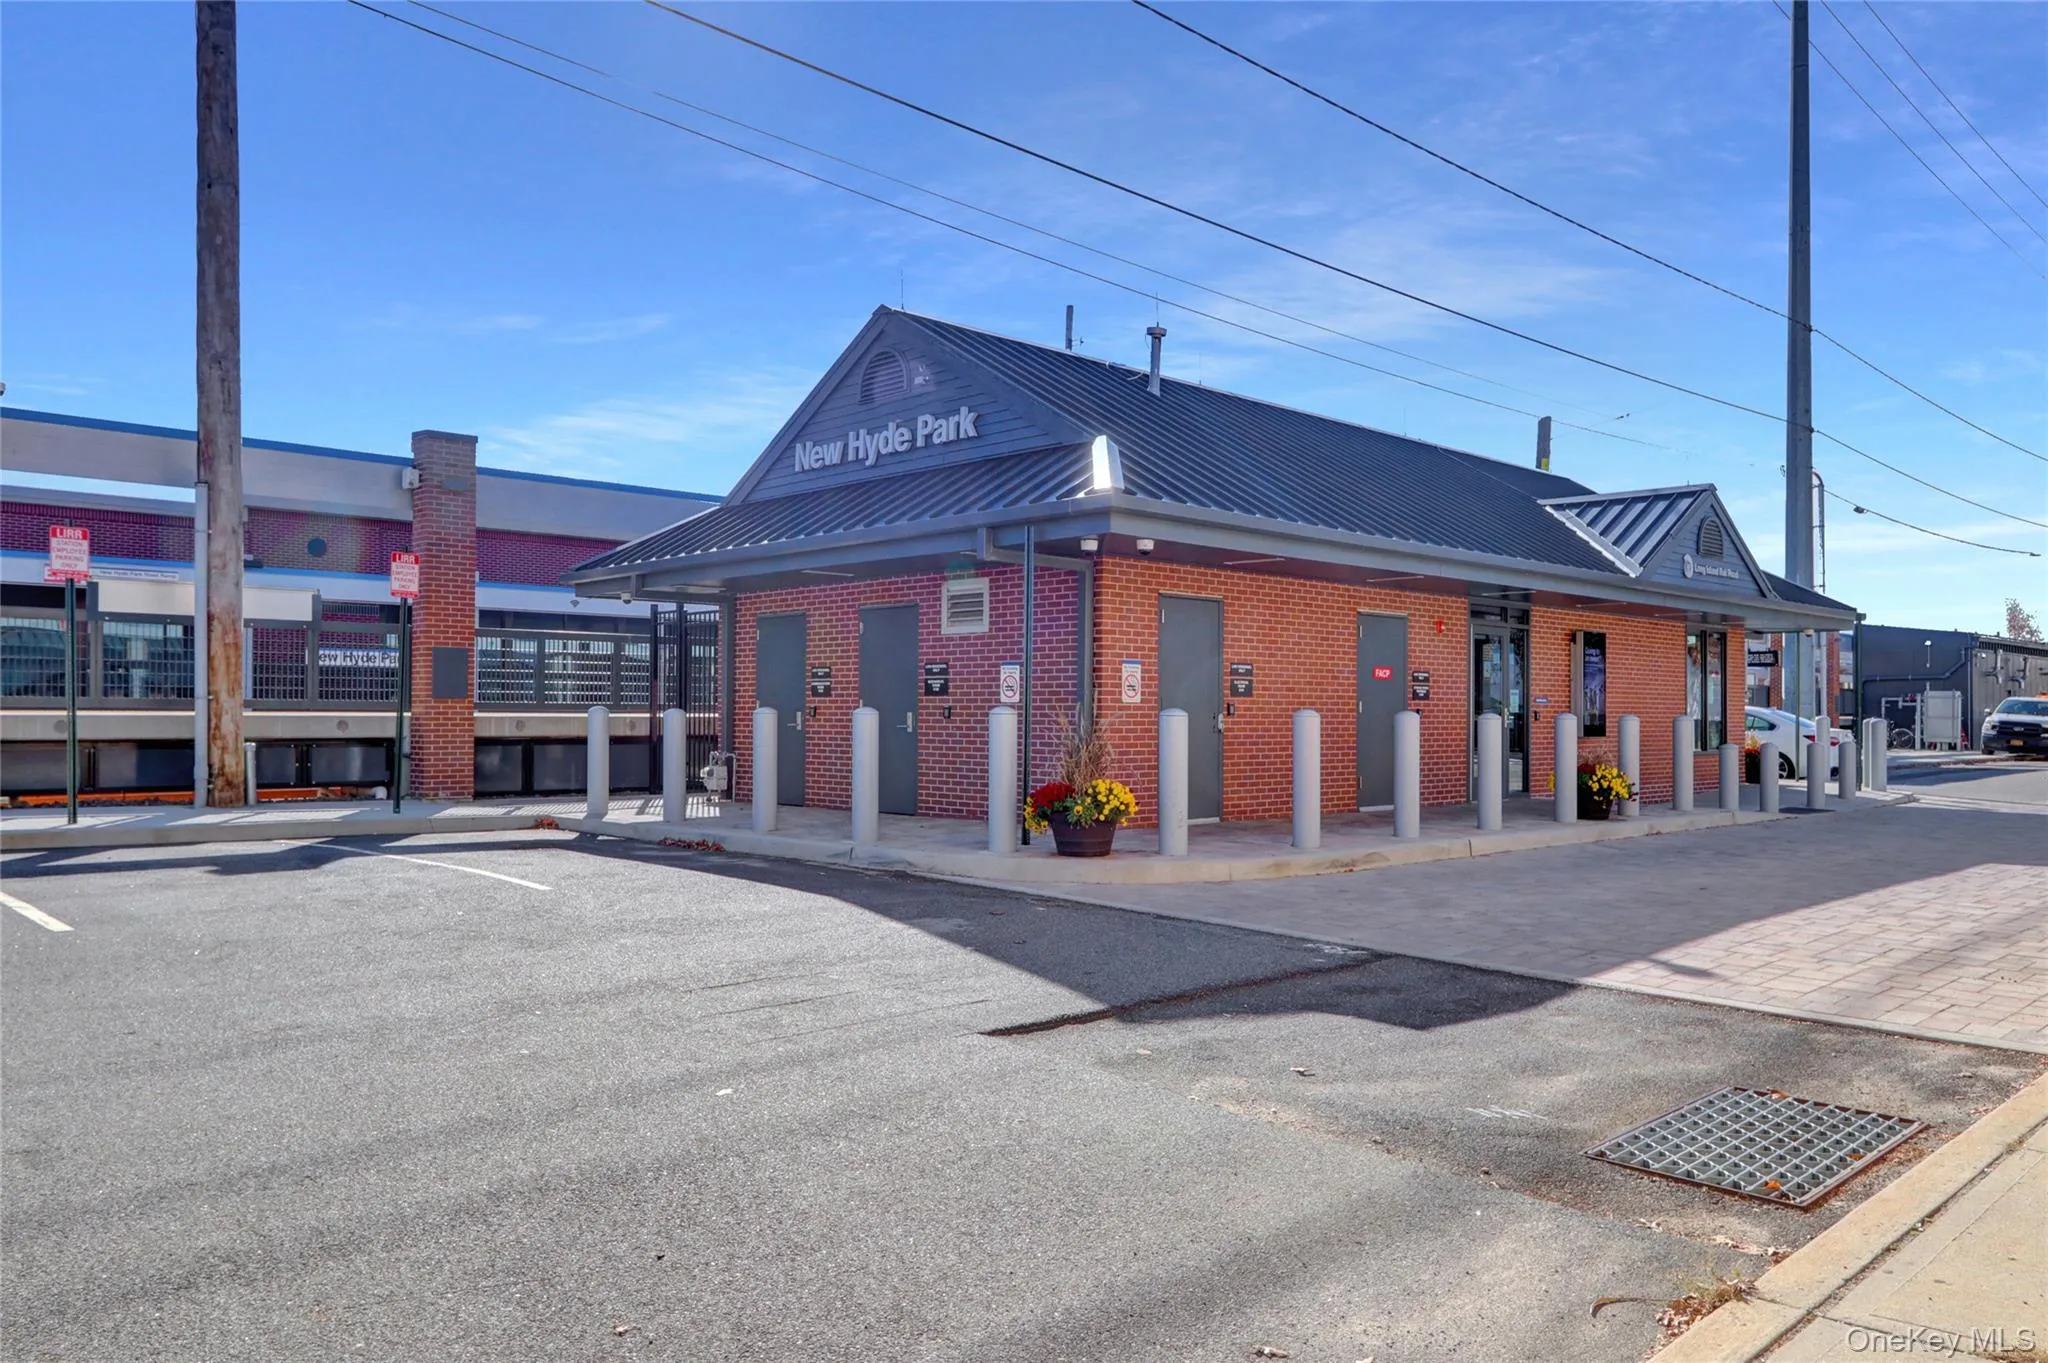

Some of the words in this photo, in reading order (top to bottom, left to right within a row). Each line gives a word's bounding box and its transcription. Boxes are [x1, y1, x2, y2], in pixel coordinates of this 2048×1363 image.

[795, 441, 844, 472] New
[848, 421, 913, 466] Hyde
[916, 406, 978, 447] Park
[56, 528, 82, 539] LIRR
[396, 553, 415, 564] LIRR
[319, 653, 338, 662] ew
[343, 652, 377, 665] Hyde
[381, 652, 398, 664] Pa
